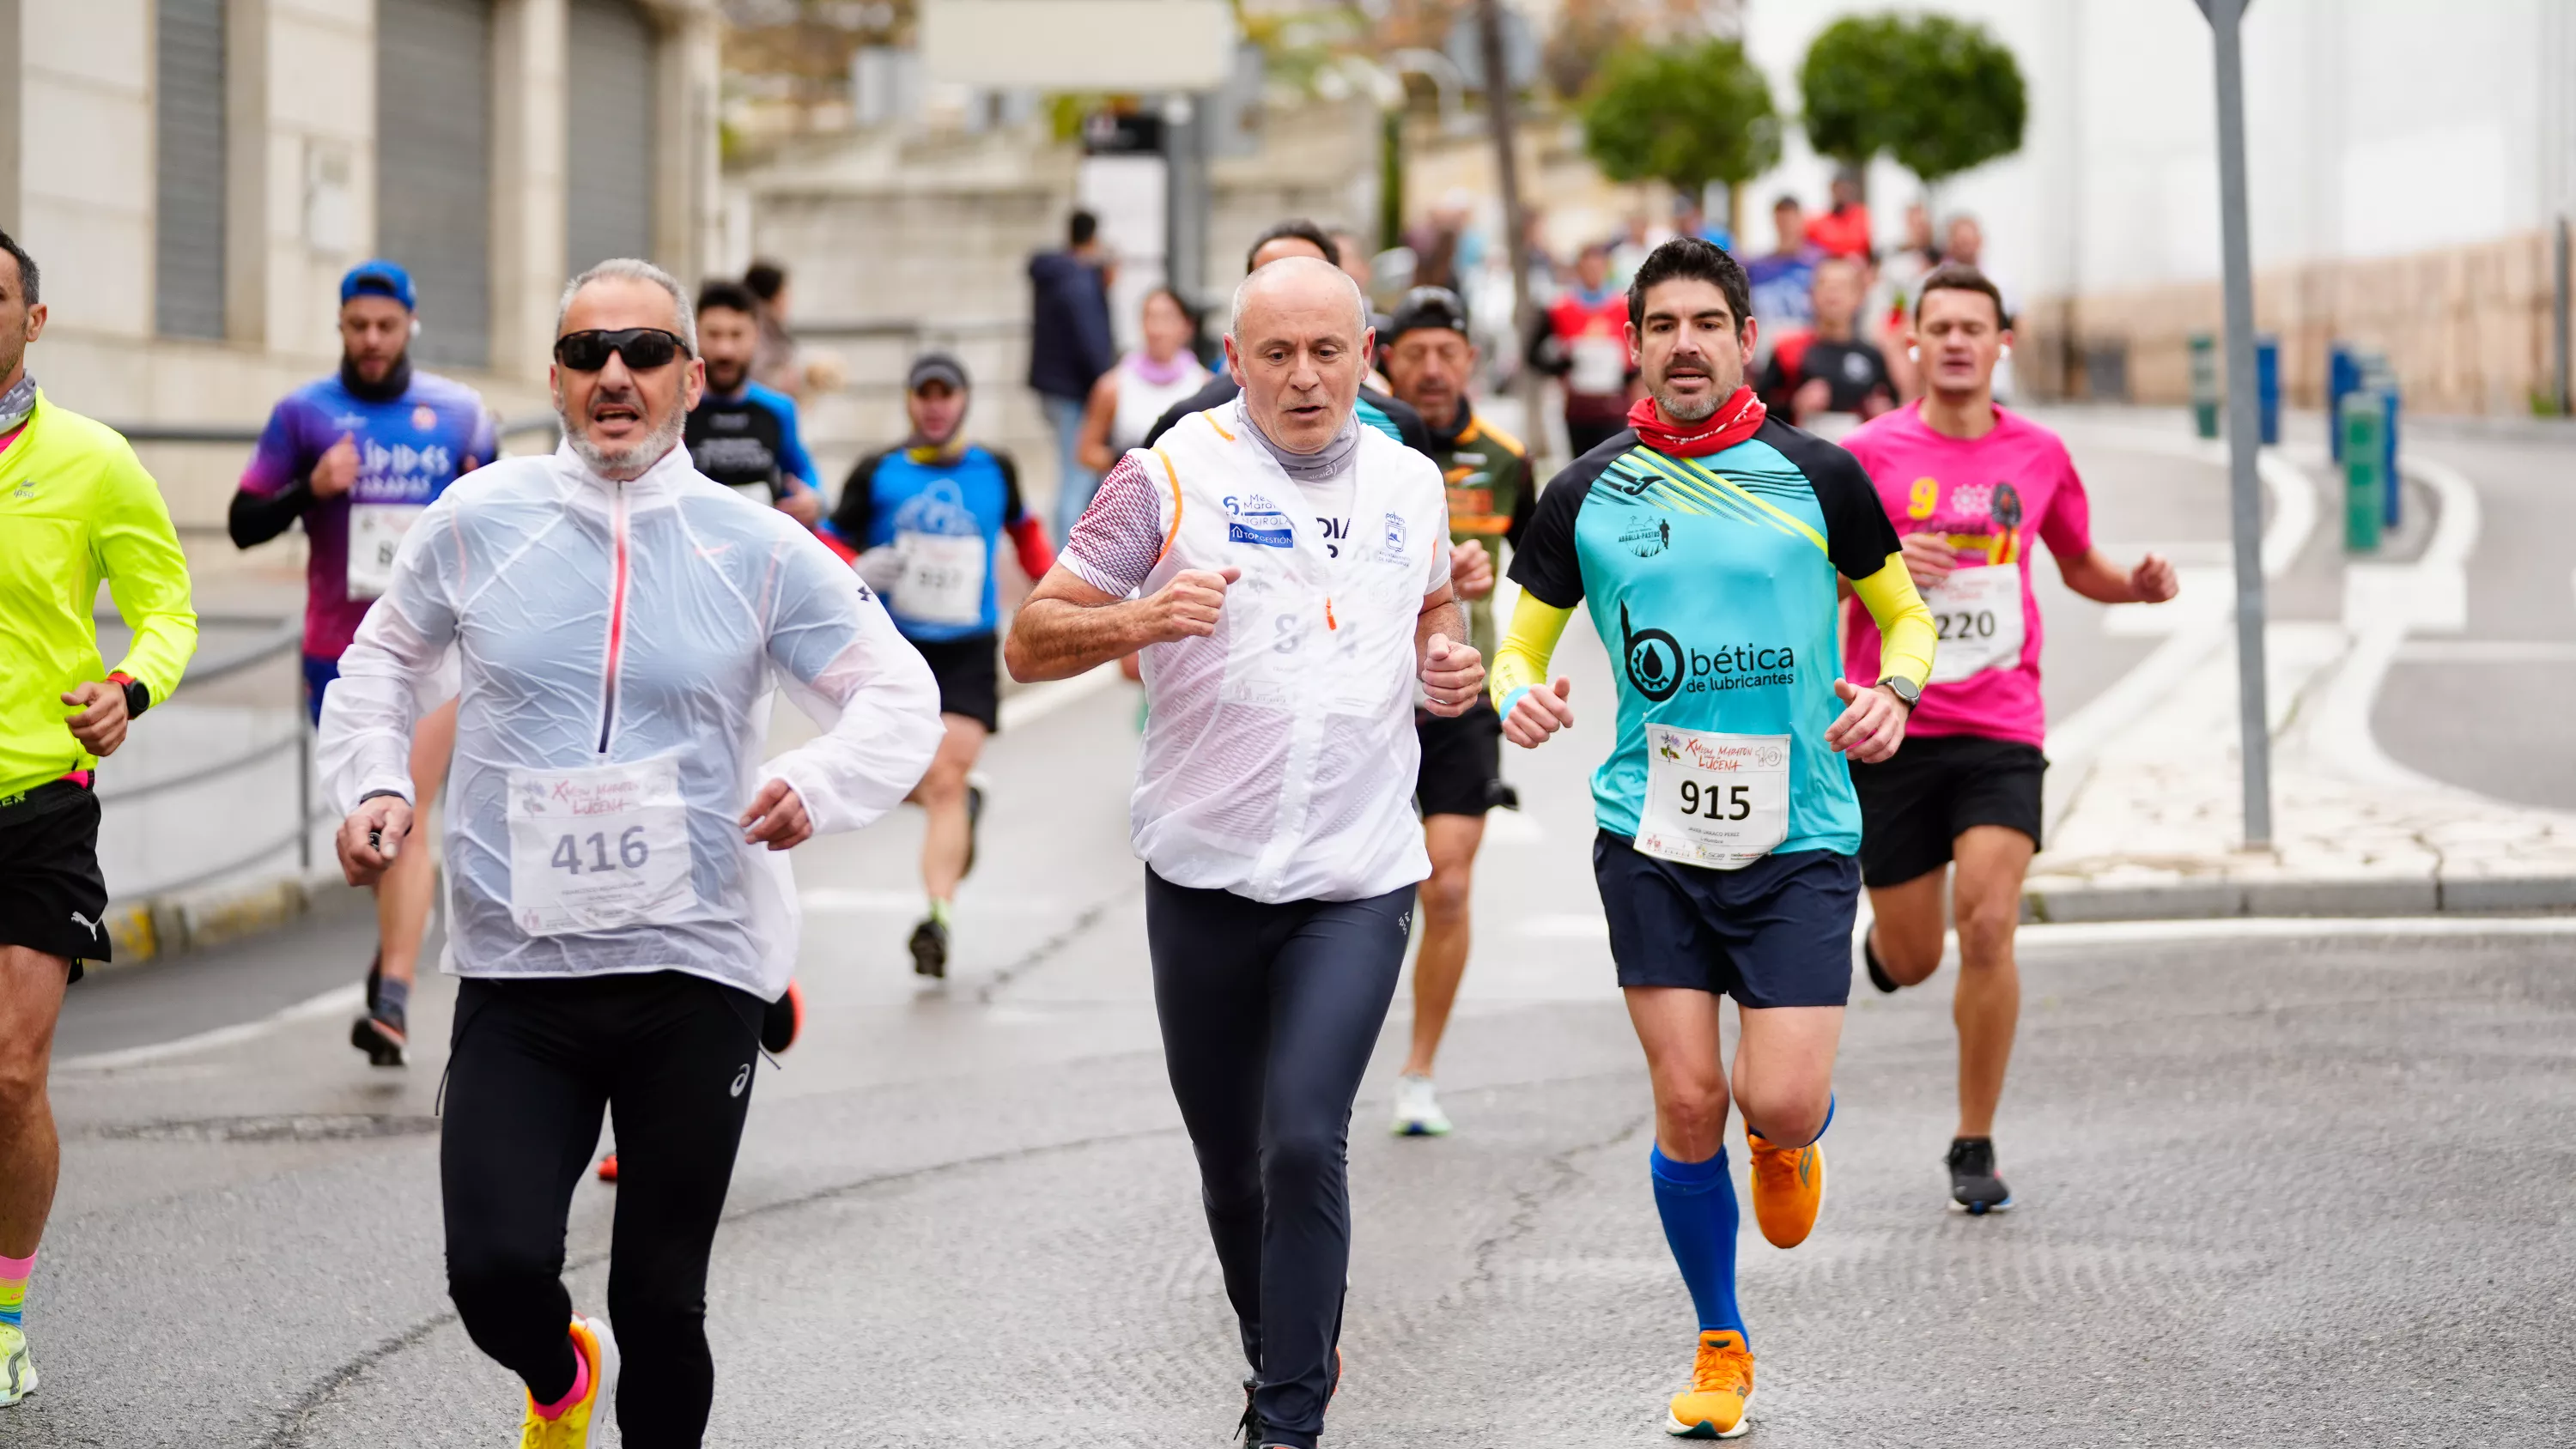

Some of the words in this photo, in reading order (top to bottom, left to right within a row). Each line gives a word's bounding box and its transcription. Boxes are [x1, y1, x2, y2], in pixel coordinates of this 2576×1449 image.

[1934, 609, 1995, 640] 220
[1691, 643, 1794, 676] bética
[1686, 679, 1706, 693] de
[1710, 672, 1794, 690] lubricantes
[1699, 755, 1744, 772] LUCENA
[1680, 779, 1751, 821] 915
[551, 825, 649, 875] 416
